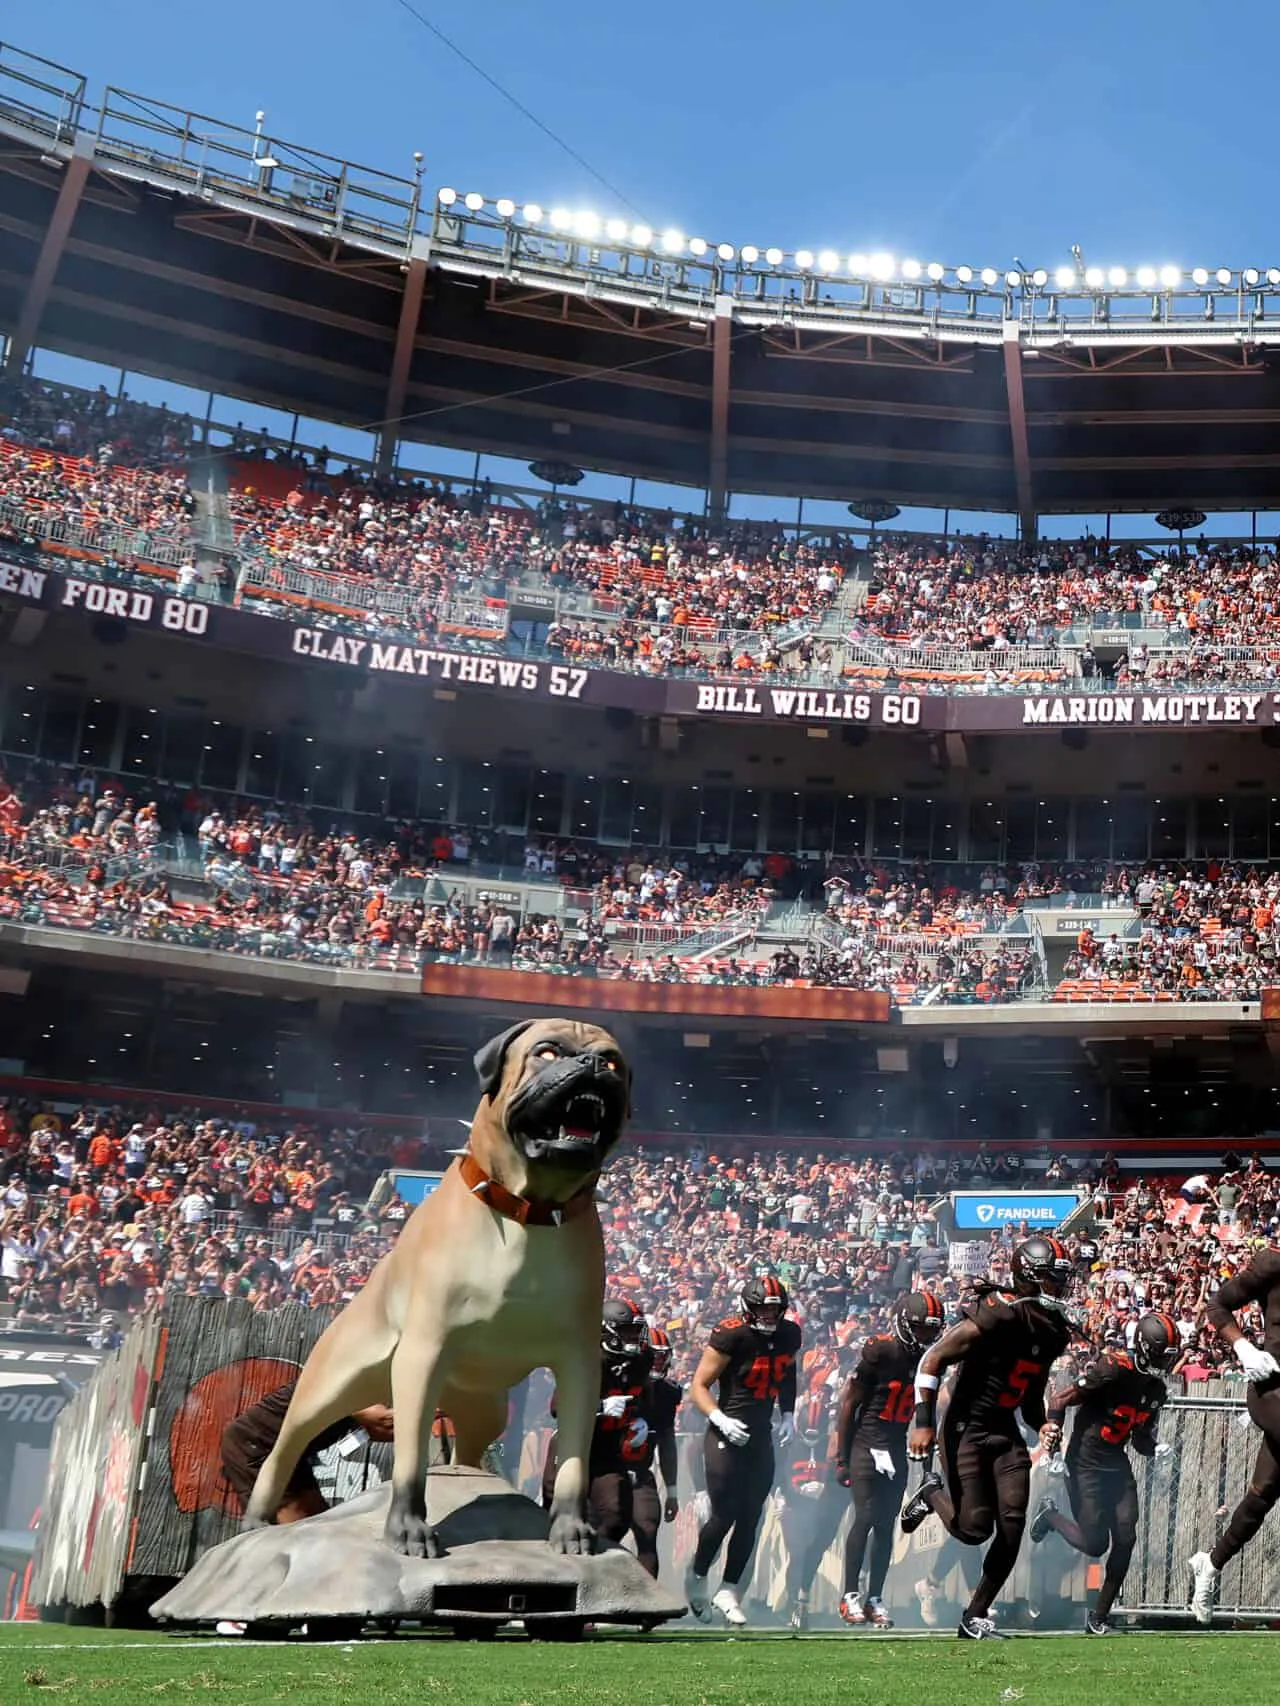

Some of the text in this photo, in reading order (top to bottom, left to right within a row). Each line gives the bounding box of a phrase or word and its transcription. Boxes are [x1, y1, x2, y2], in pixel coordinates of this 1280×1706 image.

[61, 578, 153, 622] FORD
[162, 599, 208, 635] 80
[293, 628, 588, 698] CLAY MATTHEWS 57
[697, 685, 921, 725] BILL WILLIS 60
[1023, 697, 1132, 724] MARION
[1142, 695, 1260, 722] MOTLEY
[997, 1208, 1057, 1220] FANDUEL
[999, 1360, 1042, 1408] 5
